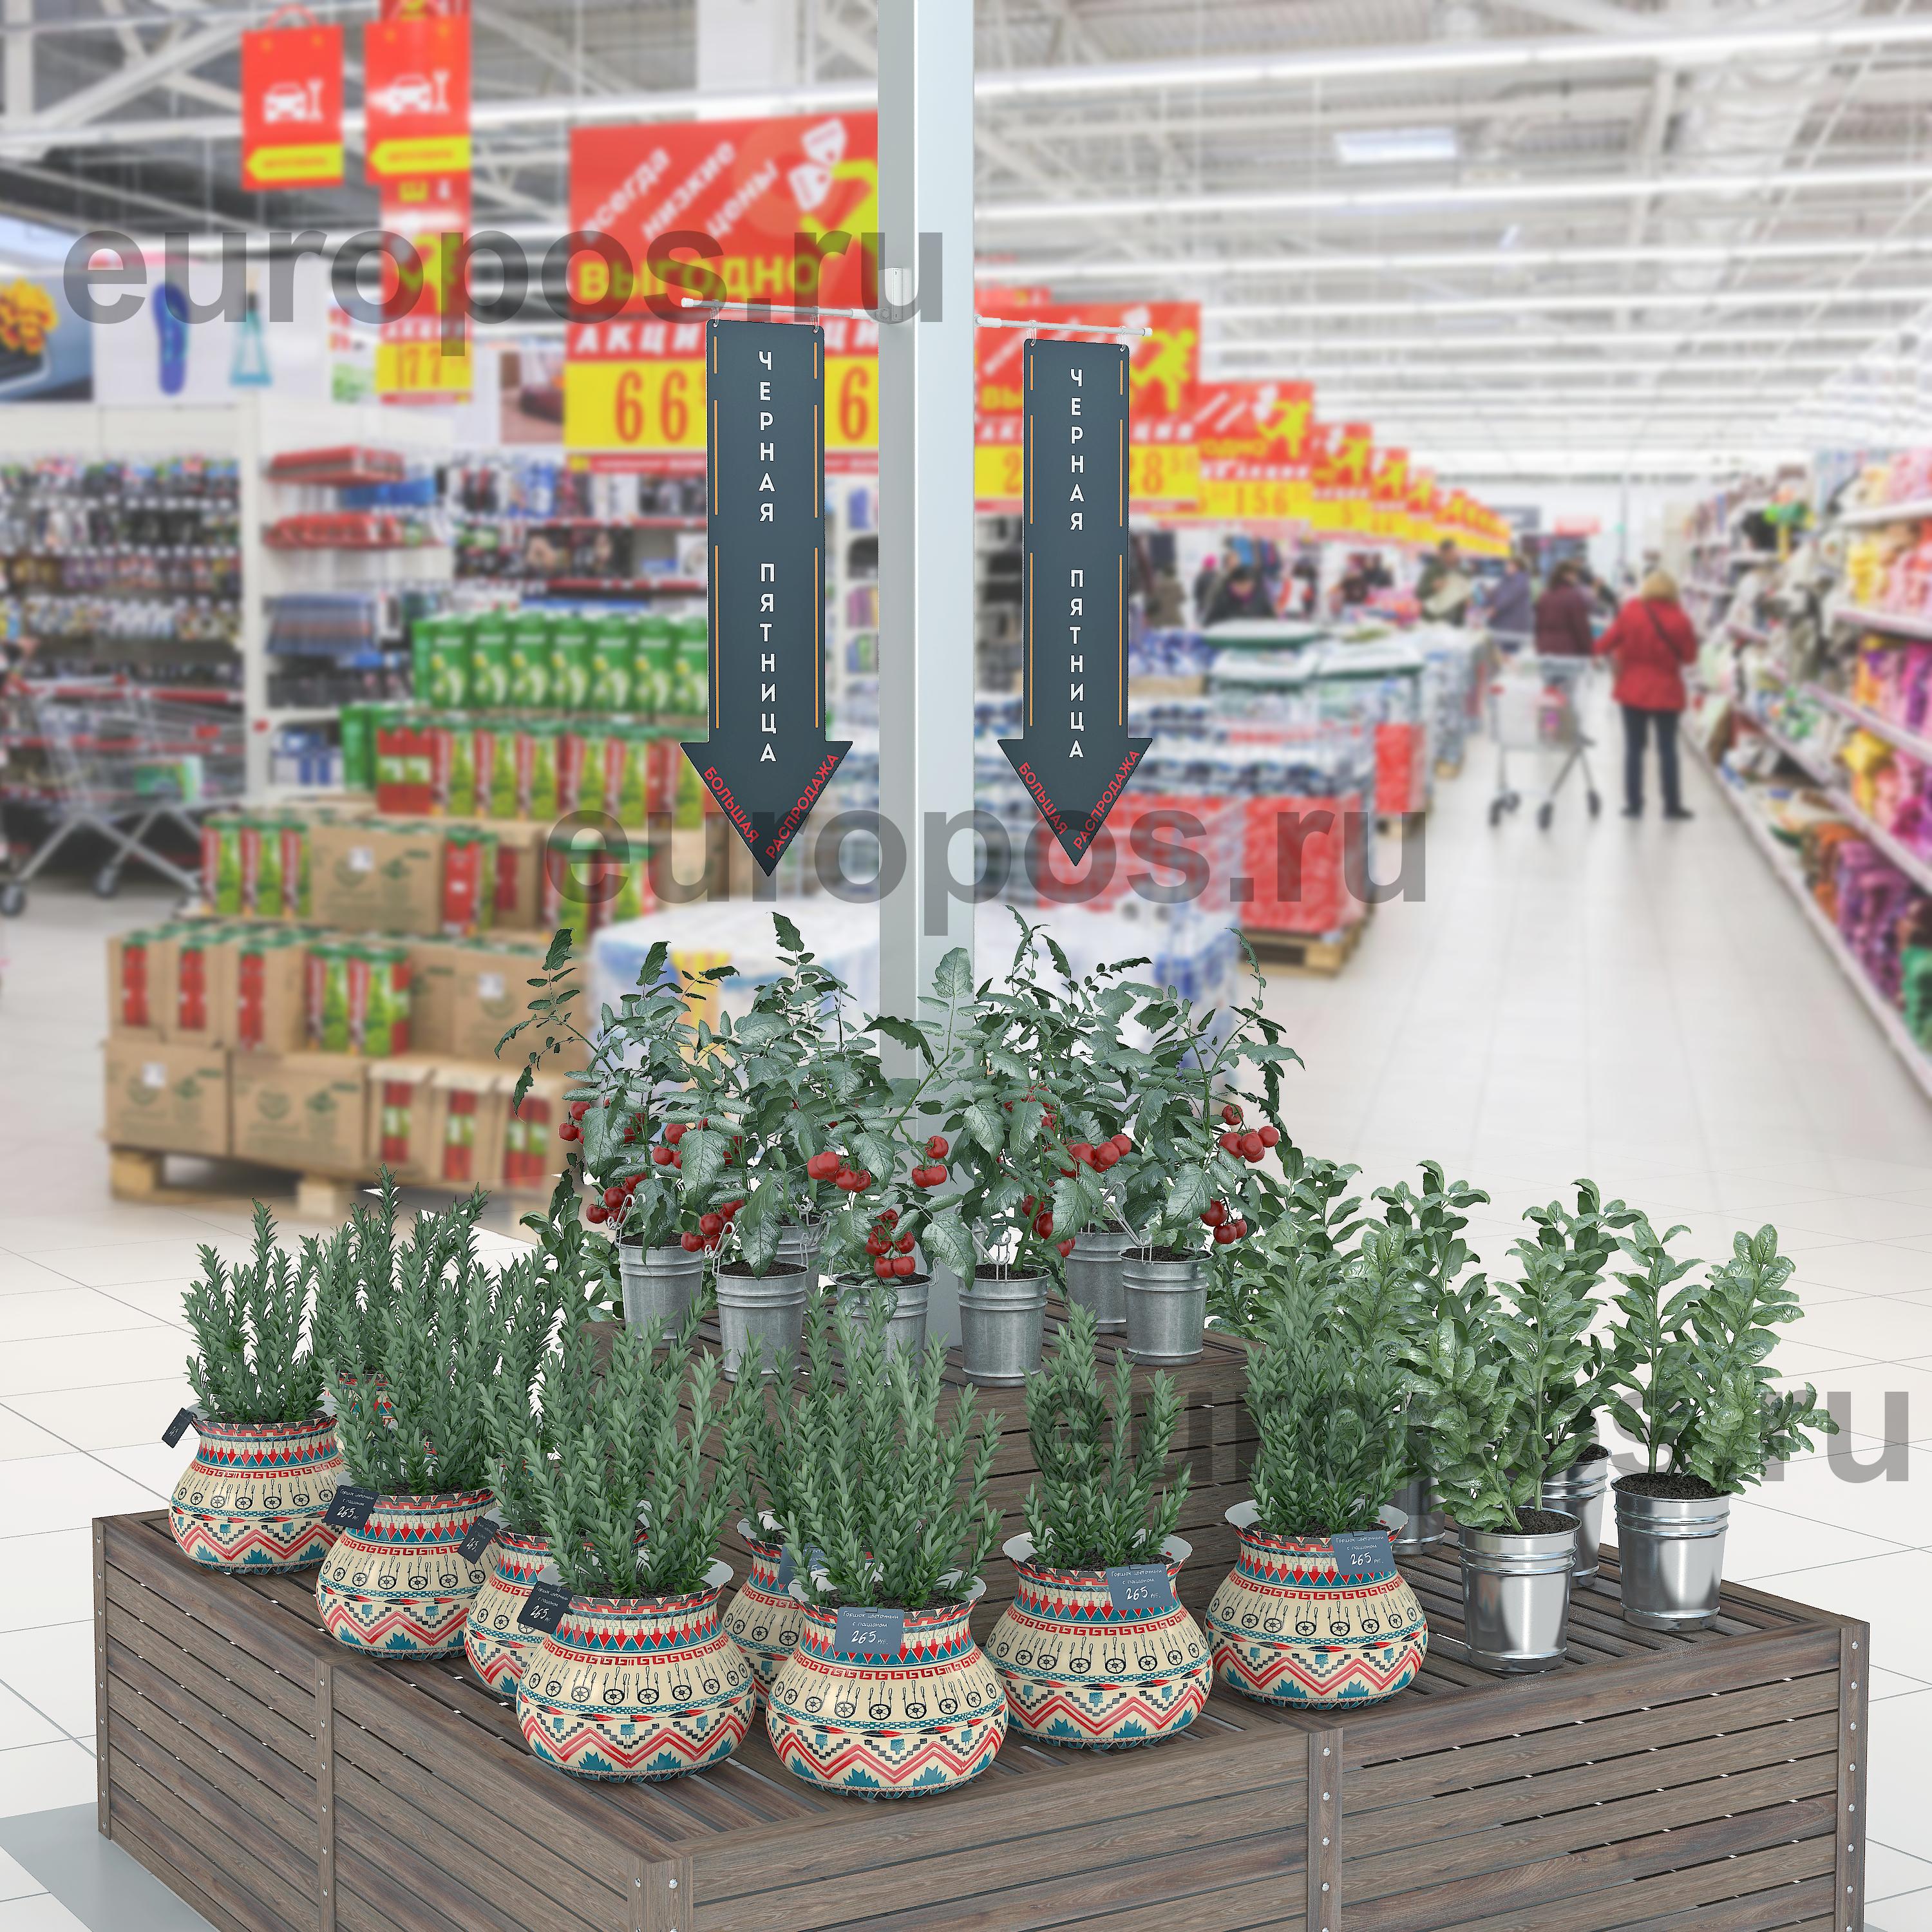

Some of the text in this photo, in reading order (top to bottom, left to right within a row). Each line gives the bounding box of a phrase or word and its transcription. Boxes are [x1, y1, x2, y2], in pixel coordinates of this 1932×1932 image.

[579, 256, 820, 299] ВЫГОДНО
[576, 324, 699, 354] АКЦИ
[759, 351, 777, 761] ЧЕРНАЯ ПЯТНИЦА
[1068, 368, 1084, 758] ЧЕРНАЯ ПЯТНИЦА
[704, 766, 759, 843] БОЛЬШАЯ
[766, 754, 839, 859] РАСПРОДАЖА
[1018, 762, 1068, 835] БОЛЬШАЯ
[1073, 750, 1140, 850] РАСПРОДАЖА
[337, 1506, 356, 1518] 265
[1350, 1551, 1372, 1566] 265
[530, 1605, 549, 1619] 265
[1126, 1586, 1148, 1601] 265
[851, 1630, 876, 1644] 265
